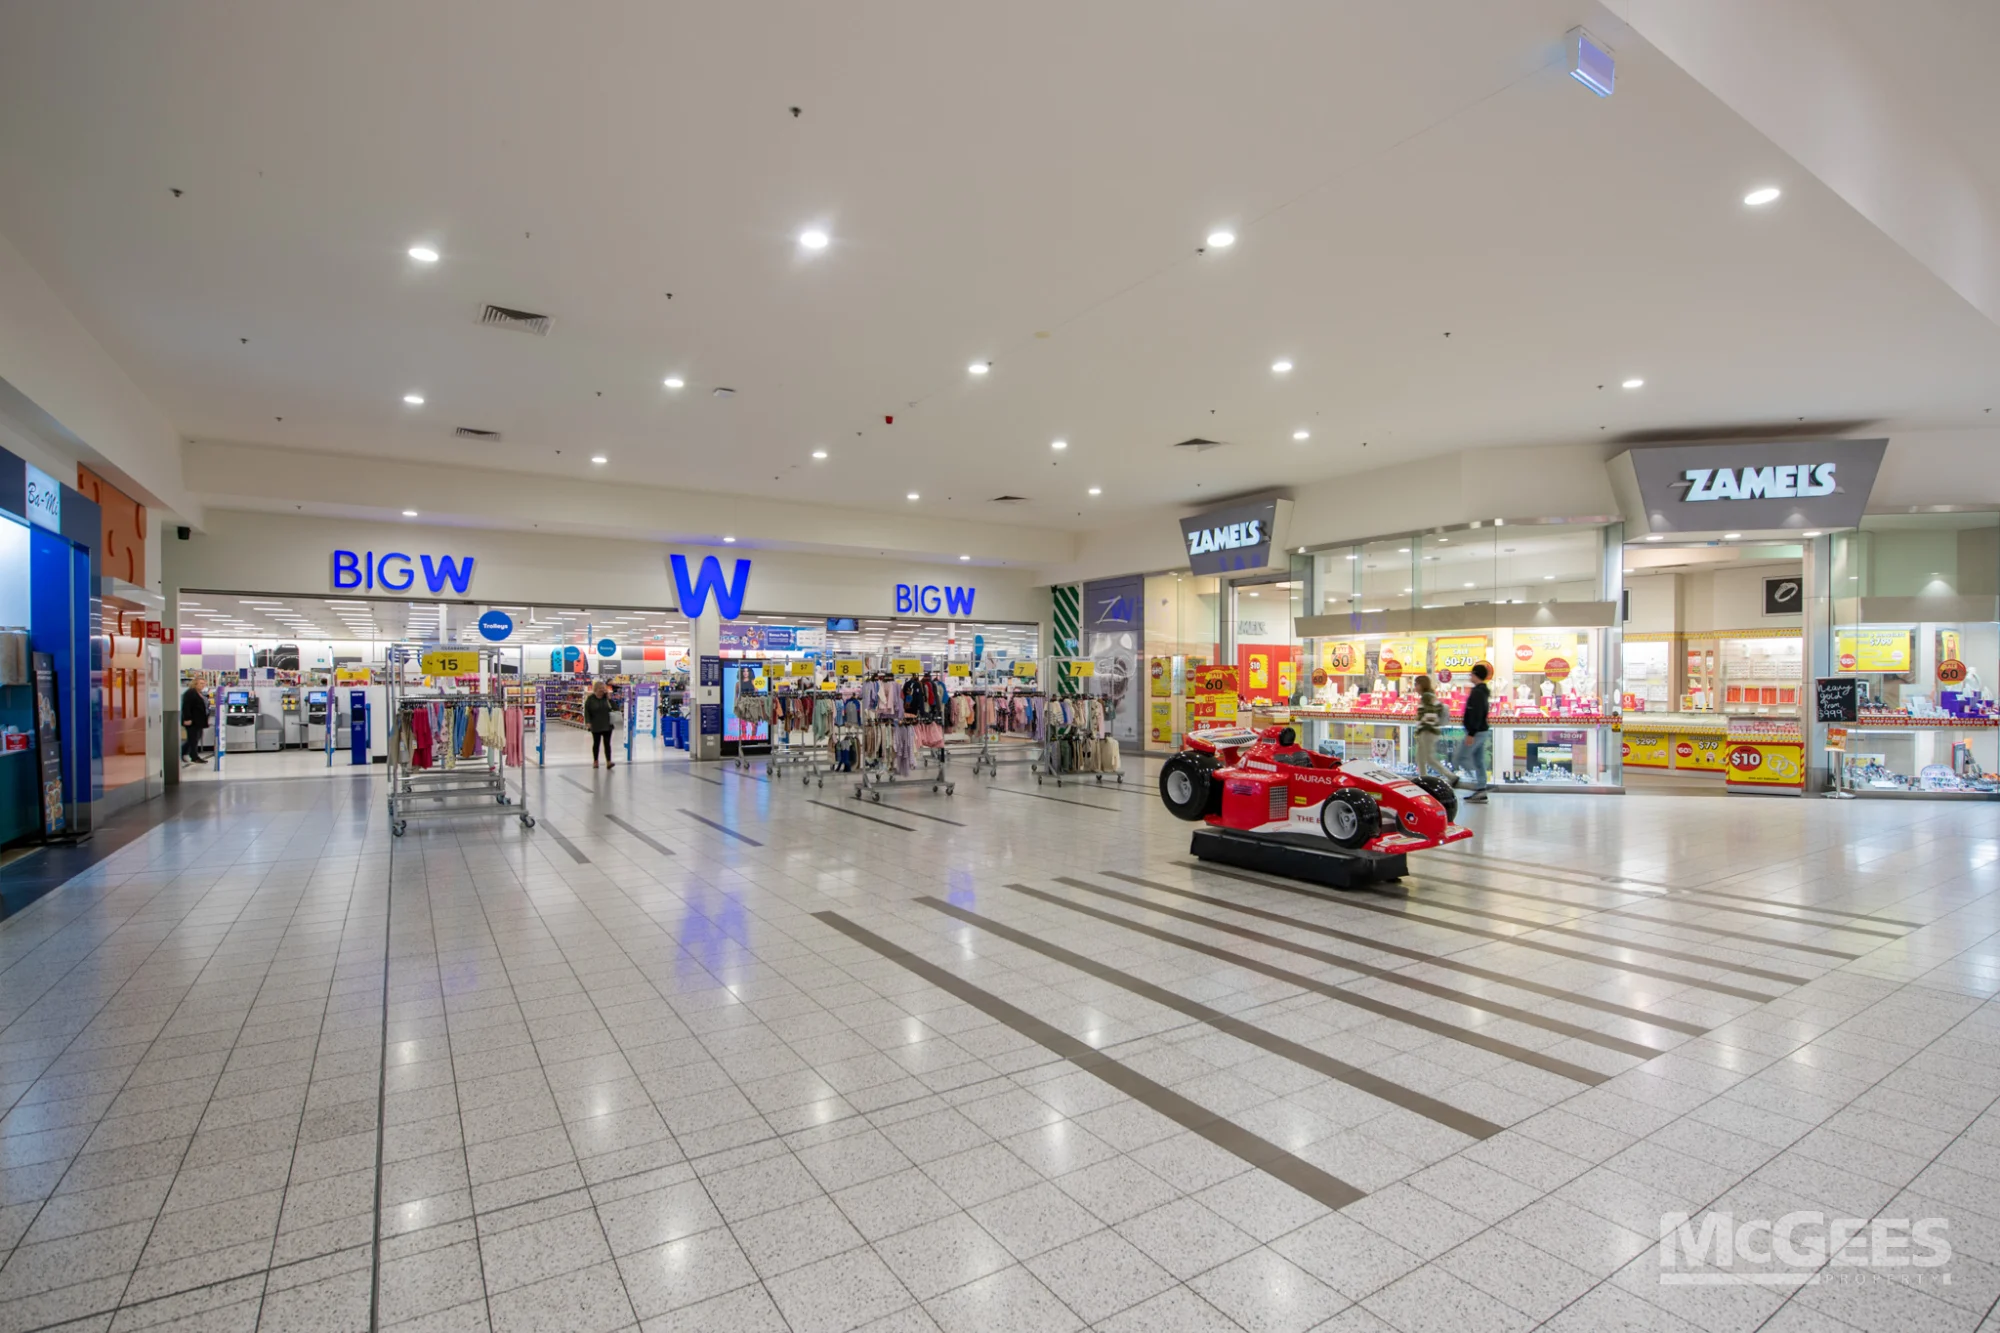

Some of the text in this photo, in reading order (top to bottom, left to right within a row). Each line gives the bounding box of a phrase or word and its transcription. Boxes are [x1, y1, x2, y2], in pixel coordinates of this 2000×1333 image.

[1685, 462, 1837, 502] ZAMEL'S
[1187, 519, 1261, 556] ZAMEL'S
[669, 553, 752, 620] W
[1332, 654, 1350, 668] 60
[1940, 669, 1959, 679] 60
[1205, 680, 1224, 691] 60
[1818, 708, 1843, 719] $999
[1635, 738, 1657, 746] $299
[1698, 741, 1718, 750] $79
[1731, 752, 1761, 767] $10
[1294, 773, 1332, 785] TAURAS
[1297, 815, 1314, 823] THE
